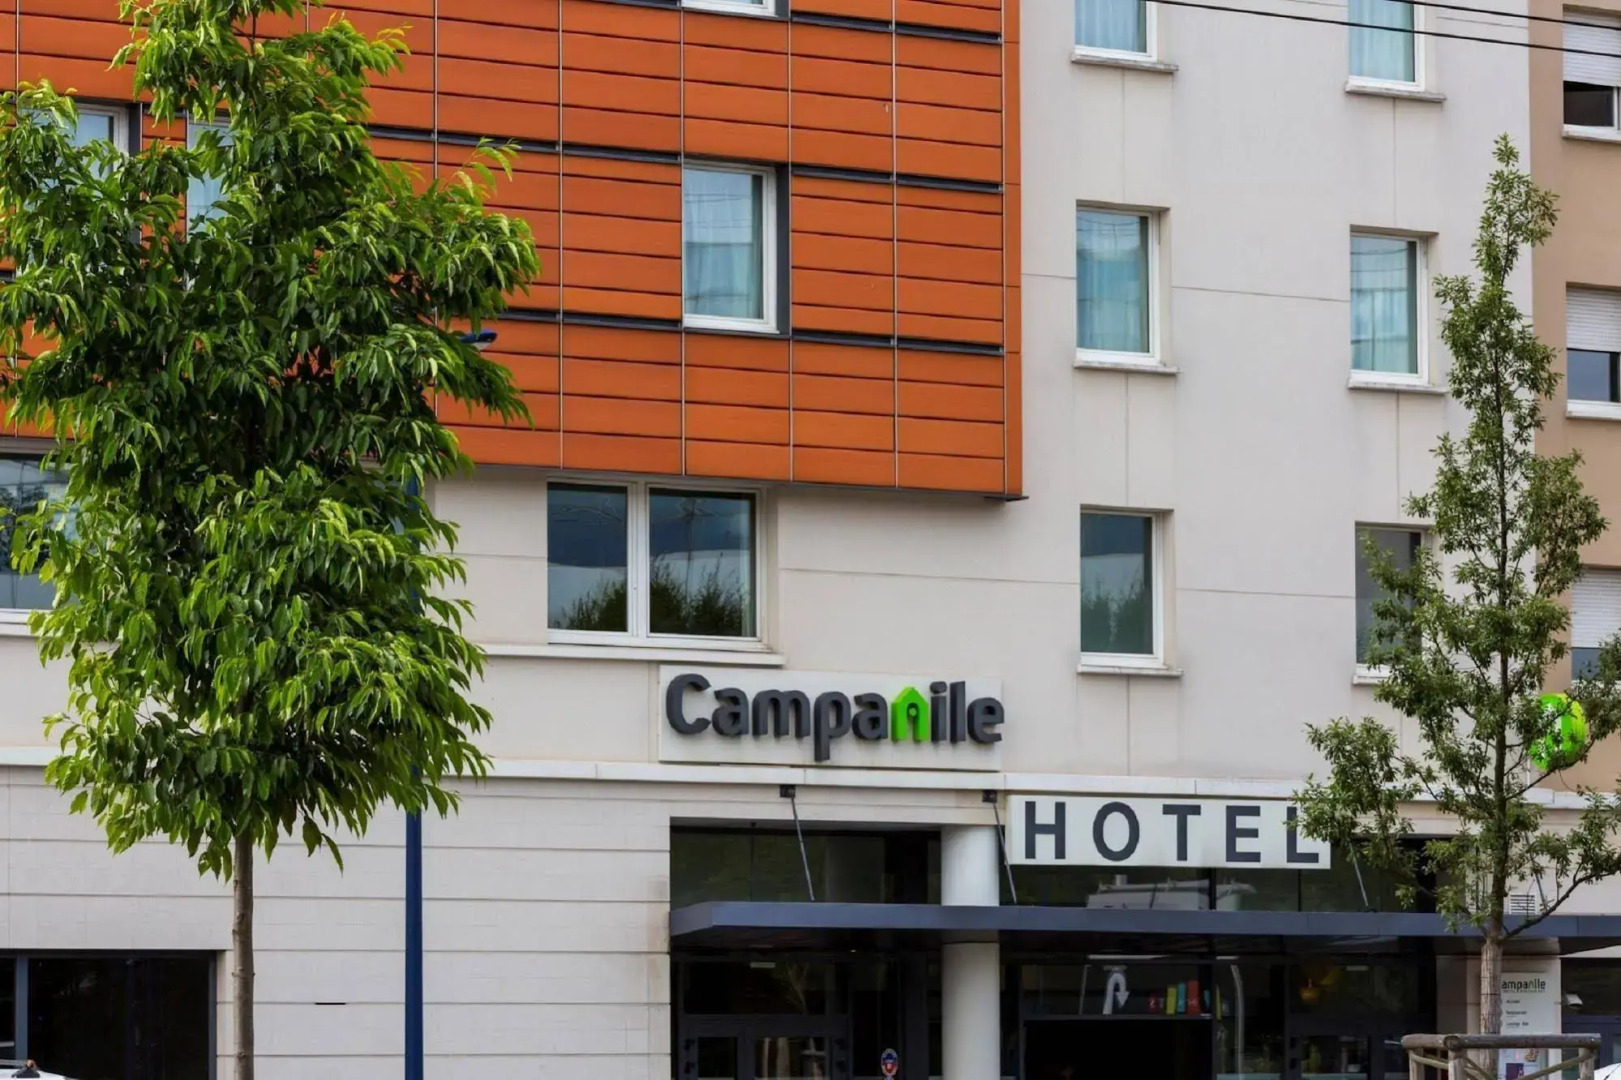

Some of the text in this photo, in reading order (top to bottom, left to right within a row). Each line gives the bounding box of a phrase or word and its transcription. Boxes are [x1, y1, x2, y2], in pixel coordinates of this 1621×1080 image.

[665, 673, 1005, 762] Campanile
[1025, 801, 1319, 863] HOTEL
[1501, 978, 1546, 992] ampanile
